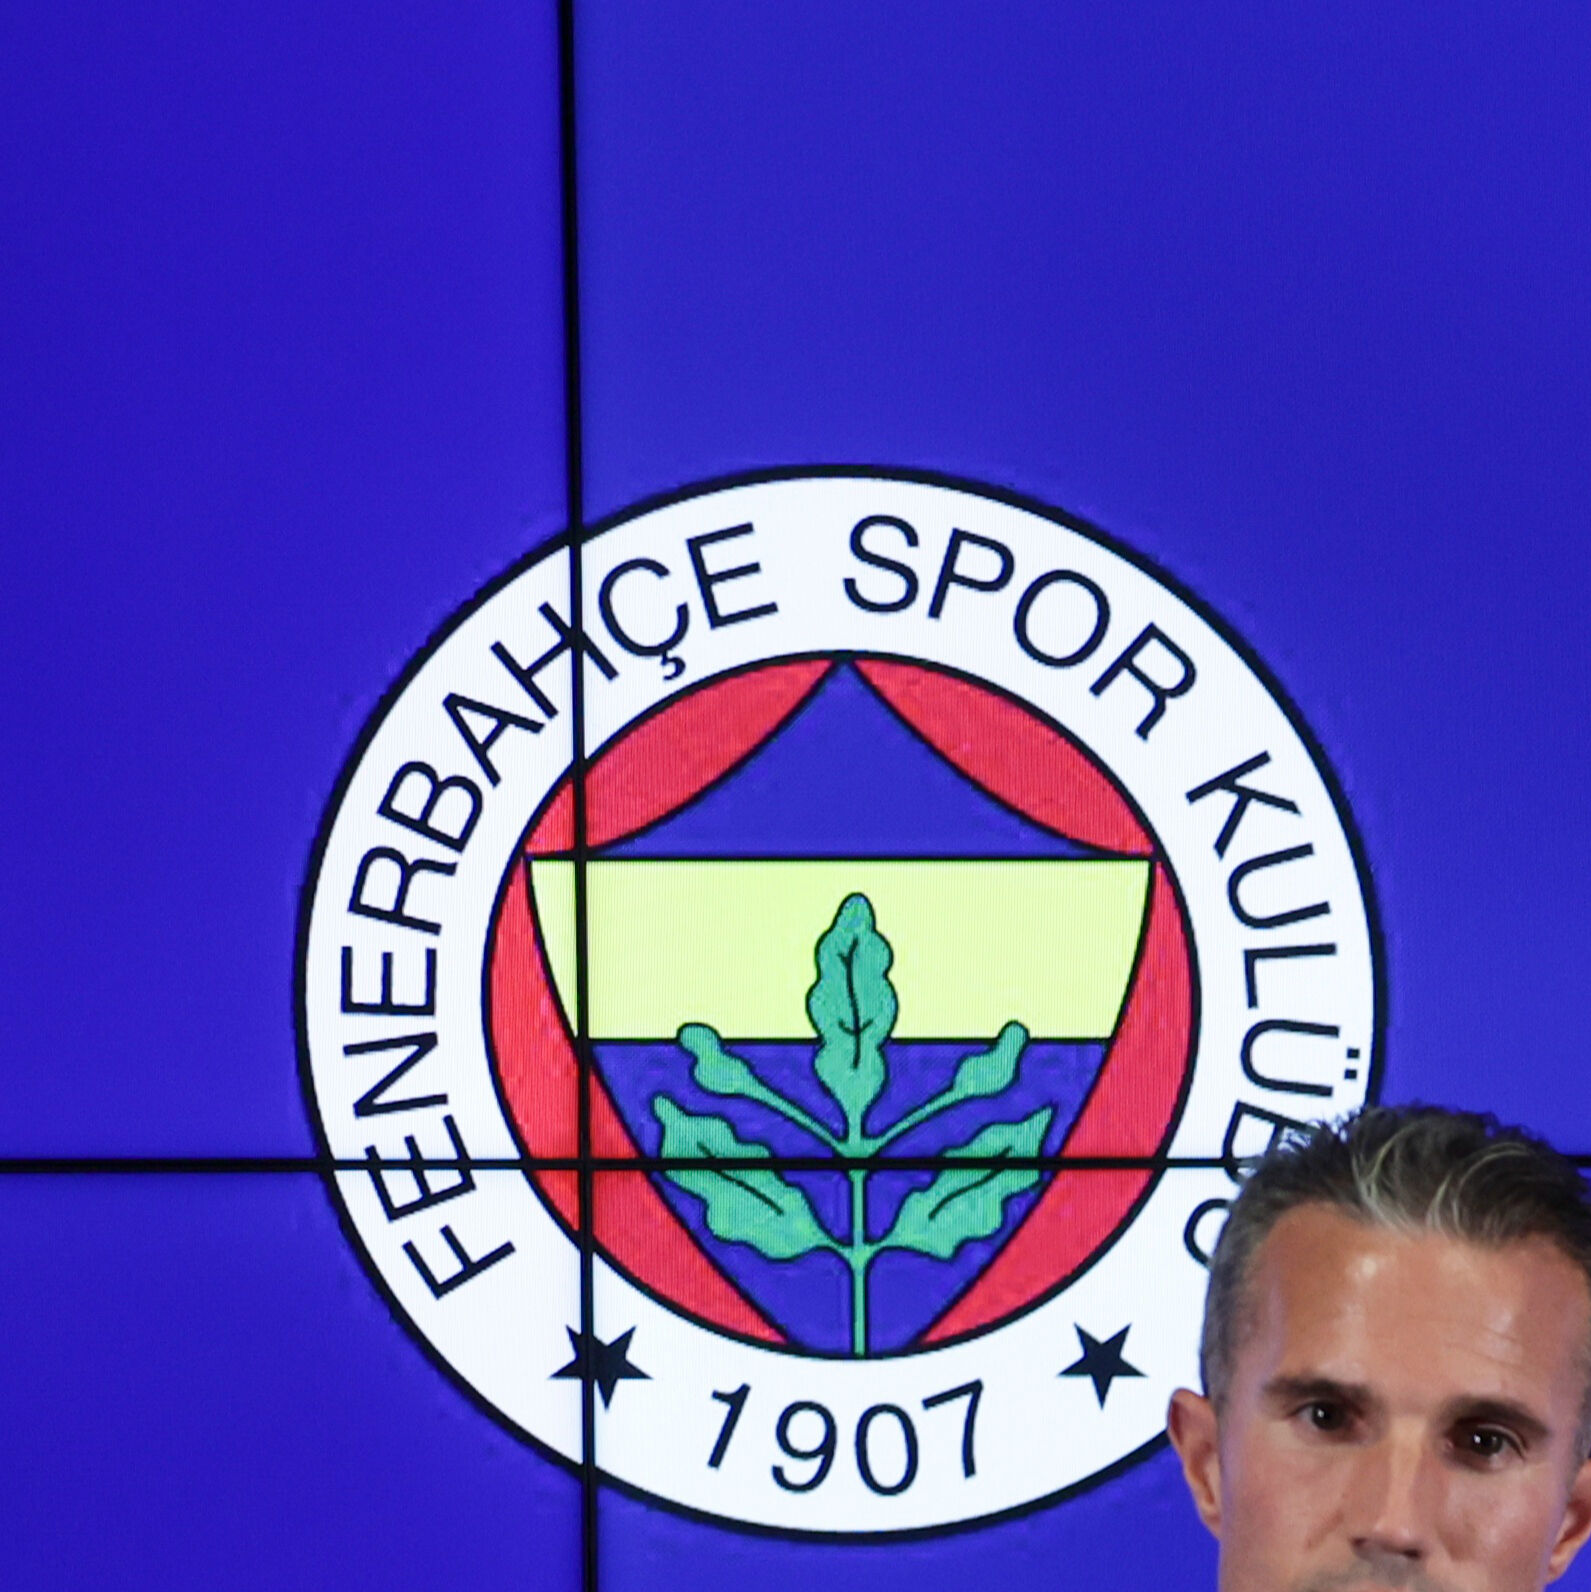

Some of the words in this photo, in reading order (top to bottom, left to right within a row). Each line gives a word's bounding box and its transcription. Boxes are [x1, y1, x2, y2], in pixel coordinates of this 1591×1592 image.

[341, 521, 779, 1300] FENERBAHÇE
[841, 513, 1200, 742] SPOR
[705, 1378, 986, 1497] 1907
